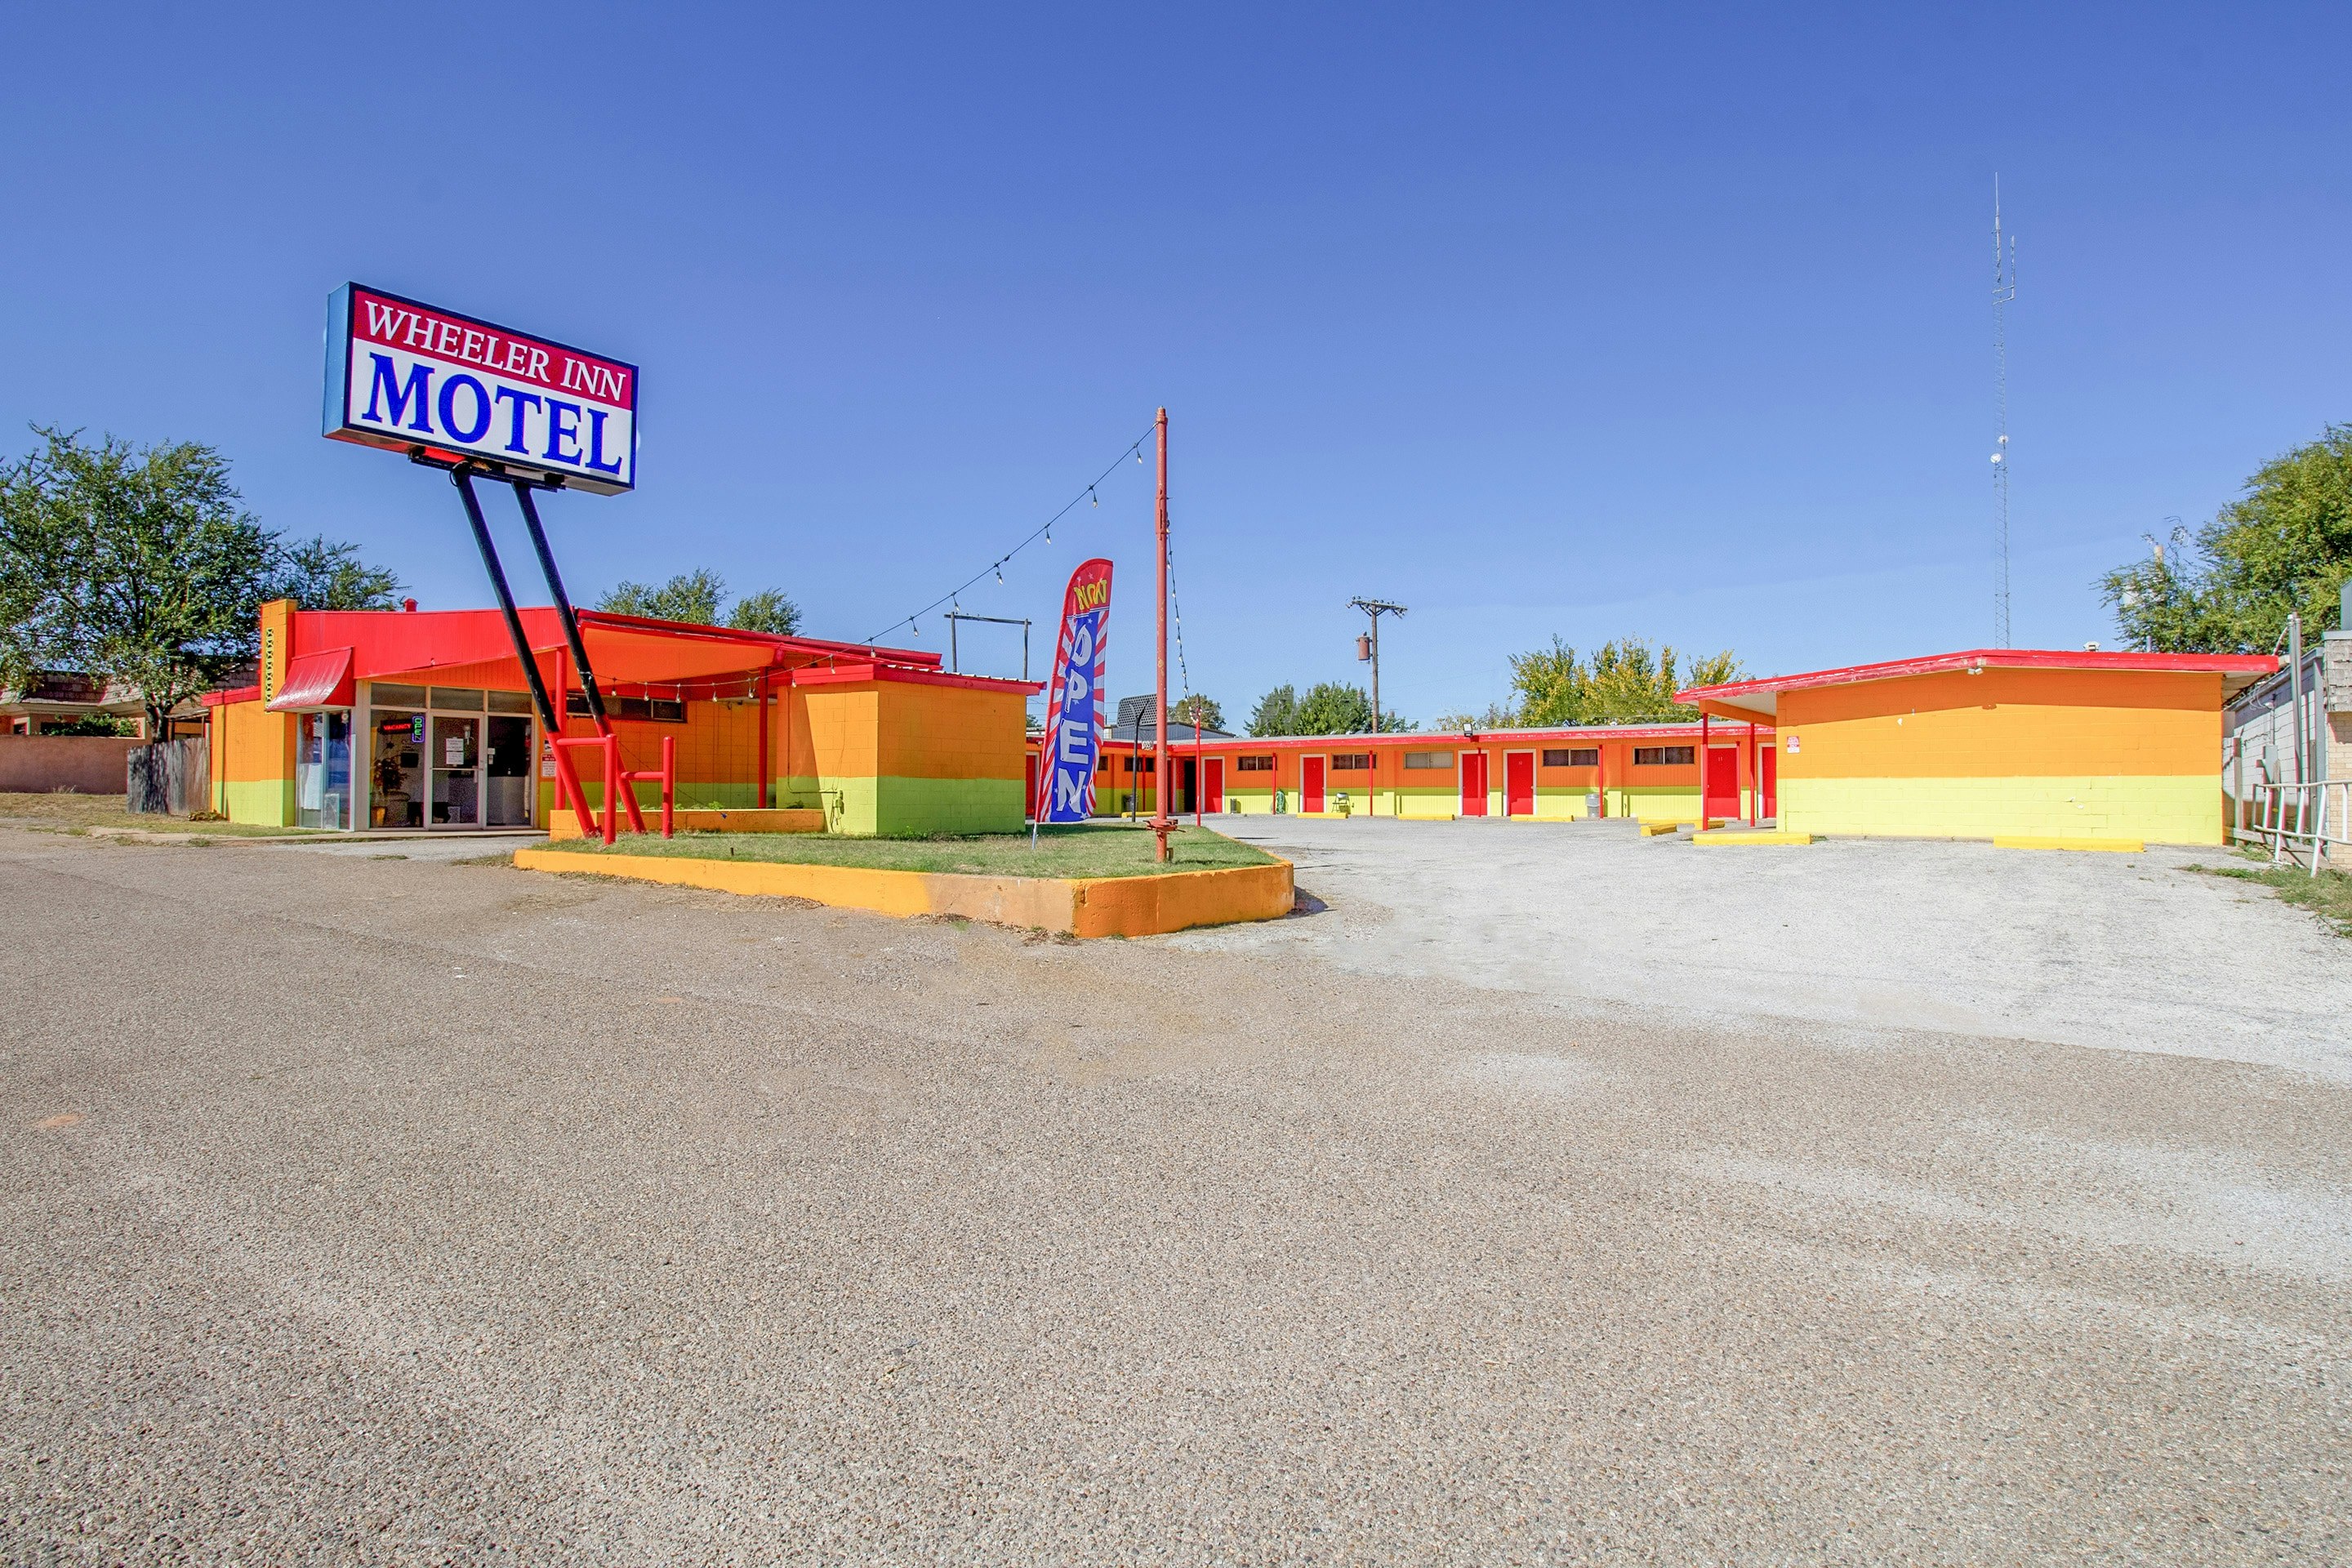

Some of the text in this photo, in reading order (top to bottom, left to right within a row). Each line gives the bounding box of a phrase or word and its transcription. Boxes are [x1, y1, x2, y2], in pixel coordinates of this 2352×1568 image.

[364, 300, 626, 402] WHEELER INN
[361, 351, 623, 475] MOTEL
[1073, 579, 1107, 611] NOW
[383, 723, 412, 731] VACANCY
[414, 717, 422, 741] OPEN
[1055, 624, 1093, 813] OPEN
